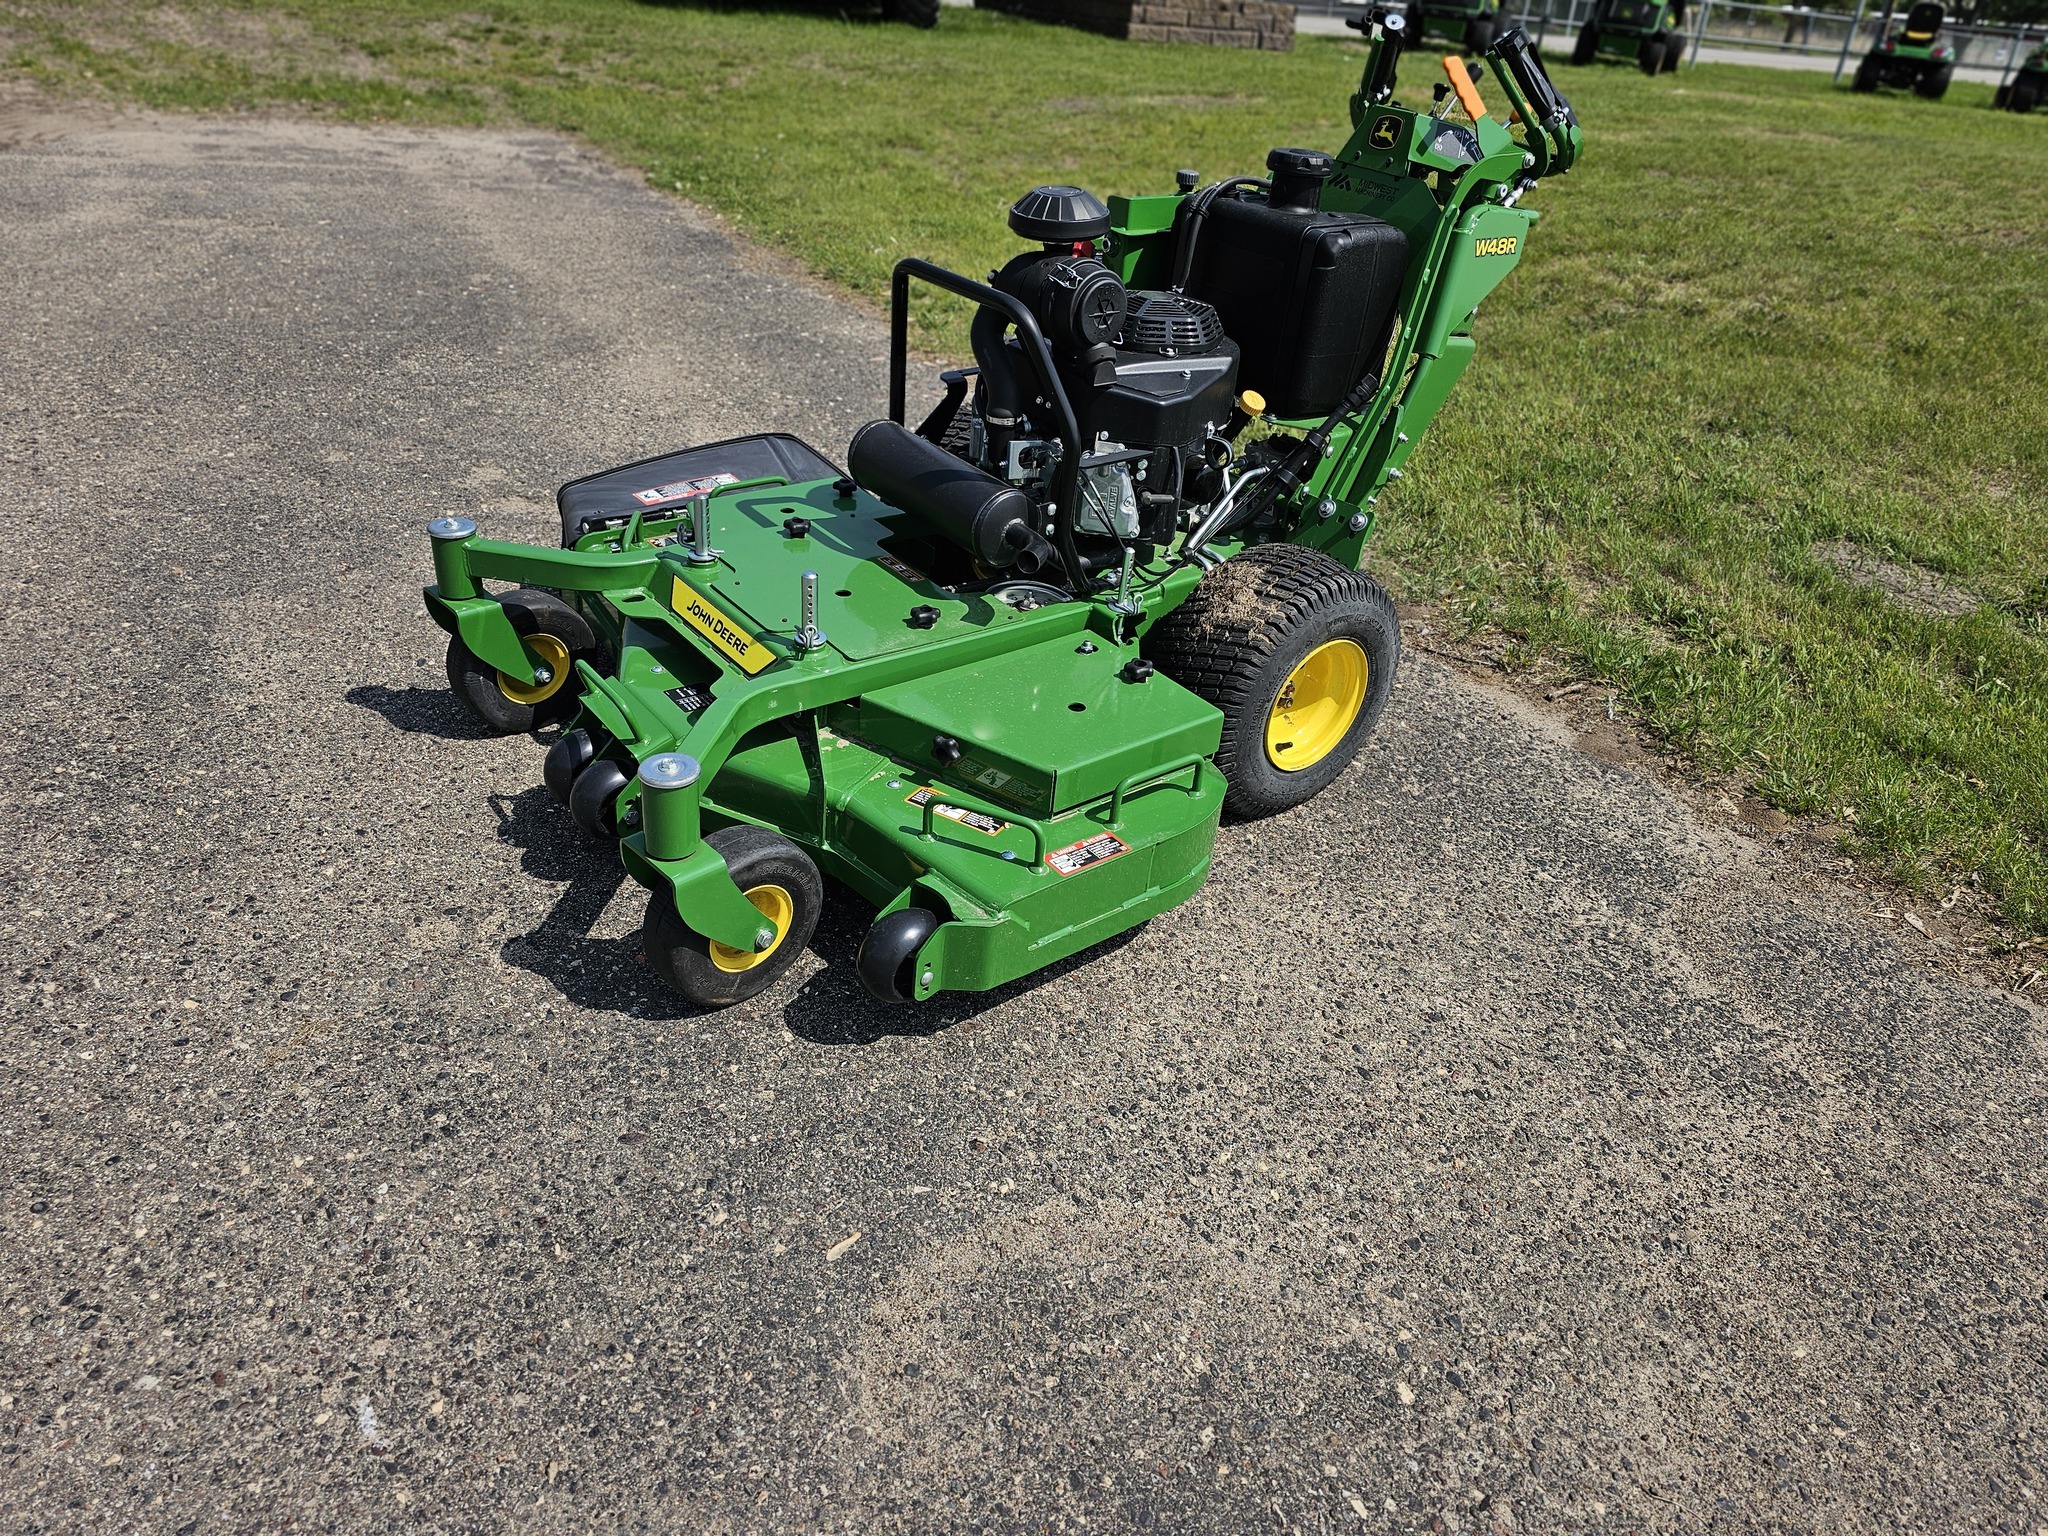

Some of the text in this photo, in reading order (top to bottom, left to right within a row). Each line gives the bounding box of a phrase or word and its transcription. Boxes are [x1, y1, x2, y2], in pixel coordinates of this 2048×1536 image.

[1355, 187, 1387, 200] MACHINERY
[1357, 179, 1400, 195] MIDWEST
[1475, 236, 1518, 257] W48R
[686, 599, 749, 656] JOHN DEERE
